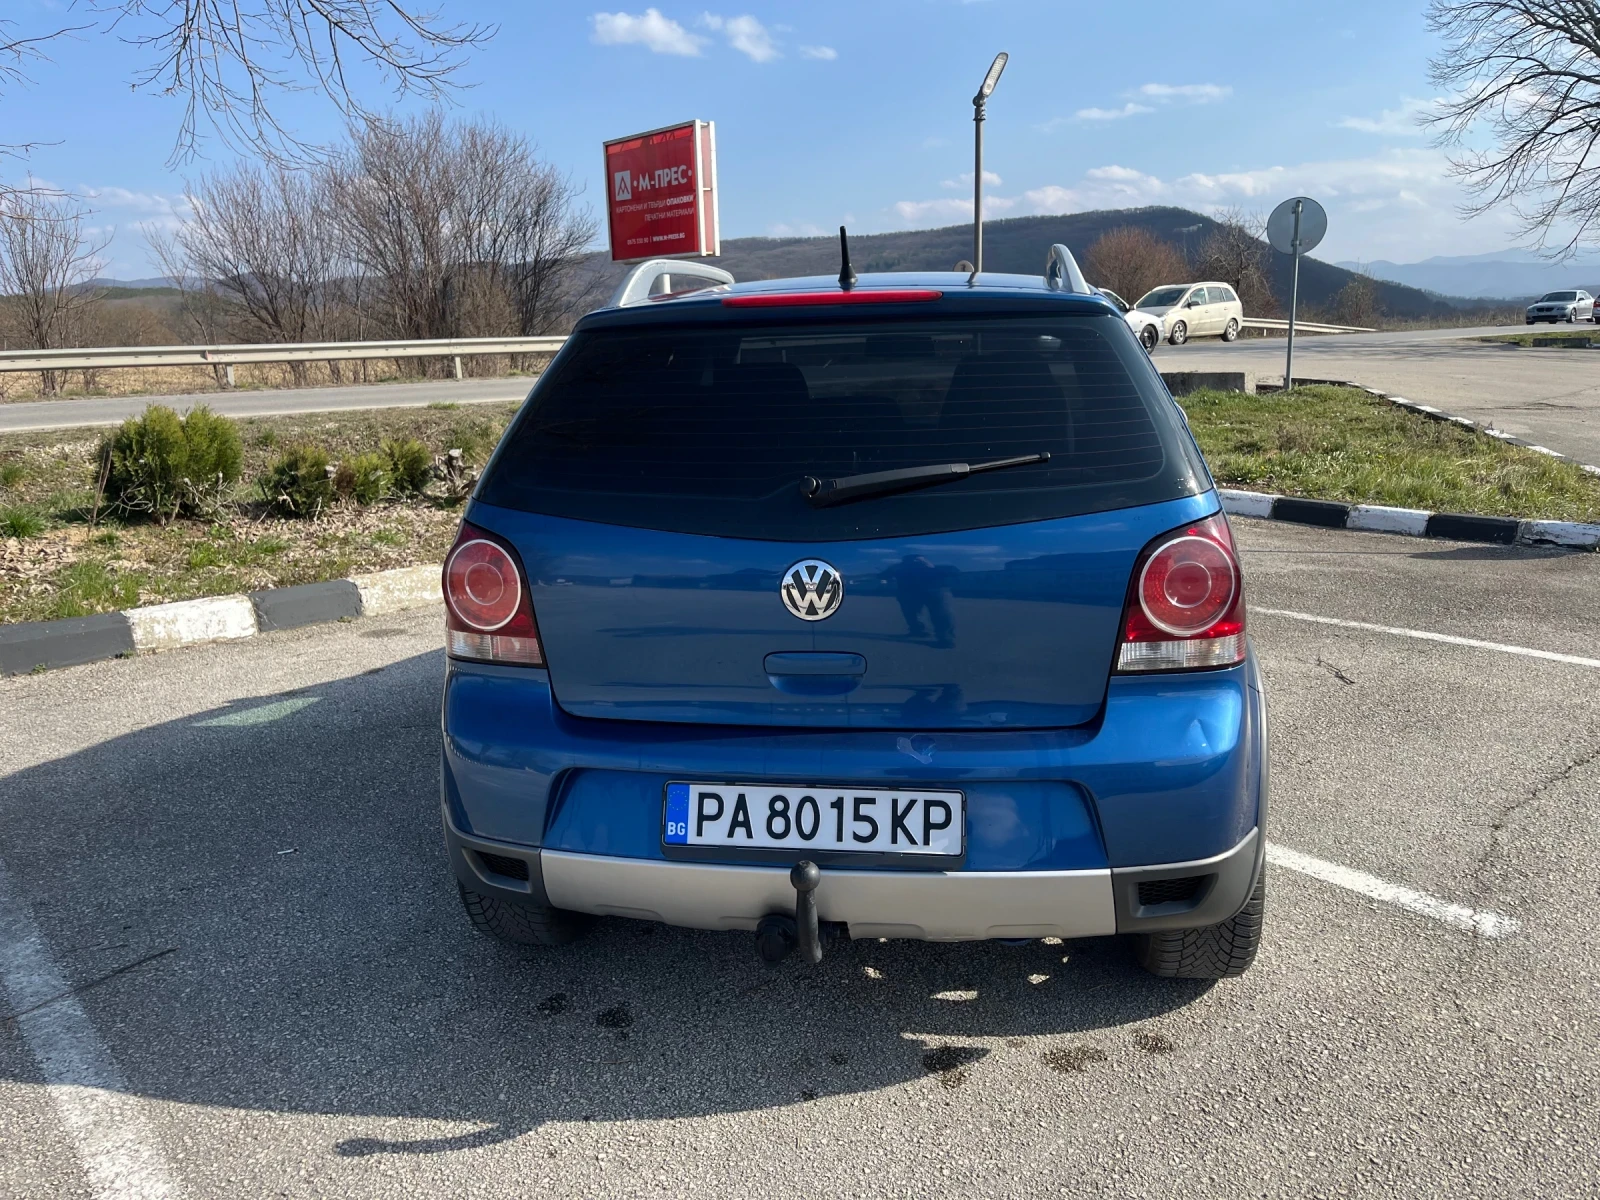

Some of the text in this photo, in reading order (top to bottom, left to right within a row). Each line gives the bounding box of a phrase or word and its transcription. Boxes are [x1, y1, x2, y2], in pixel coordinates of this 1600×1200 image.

[666, 195, 694, 206] ОПАКОВКИ
[645, 208, 695, 222] ПЕЧАТНИ МАТЕРИАЛИ
[667, 821, 686, 836] BG
[766, 795, 879, 844] 8015
